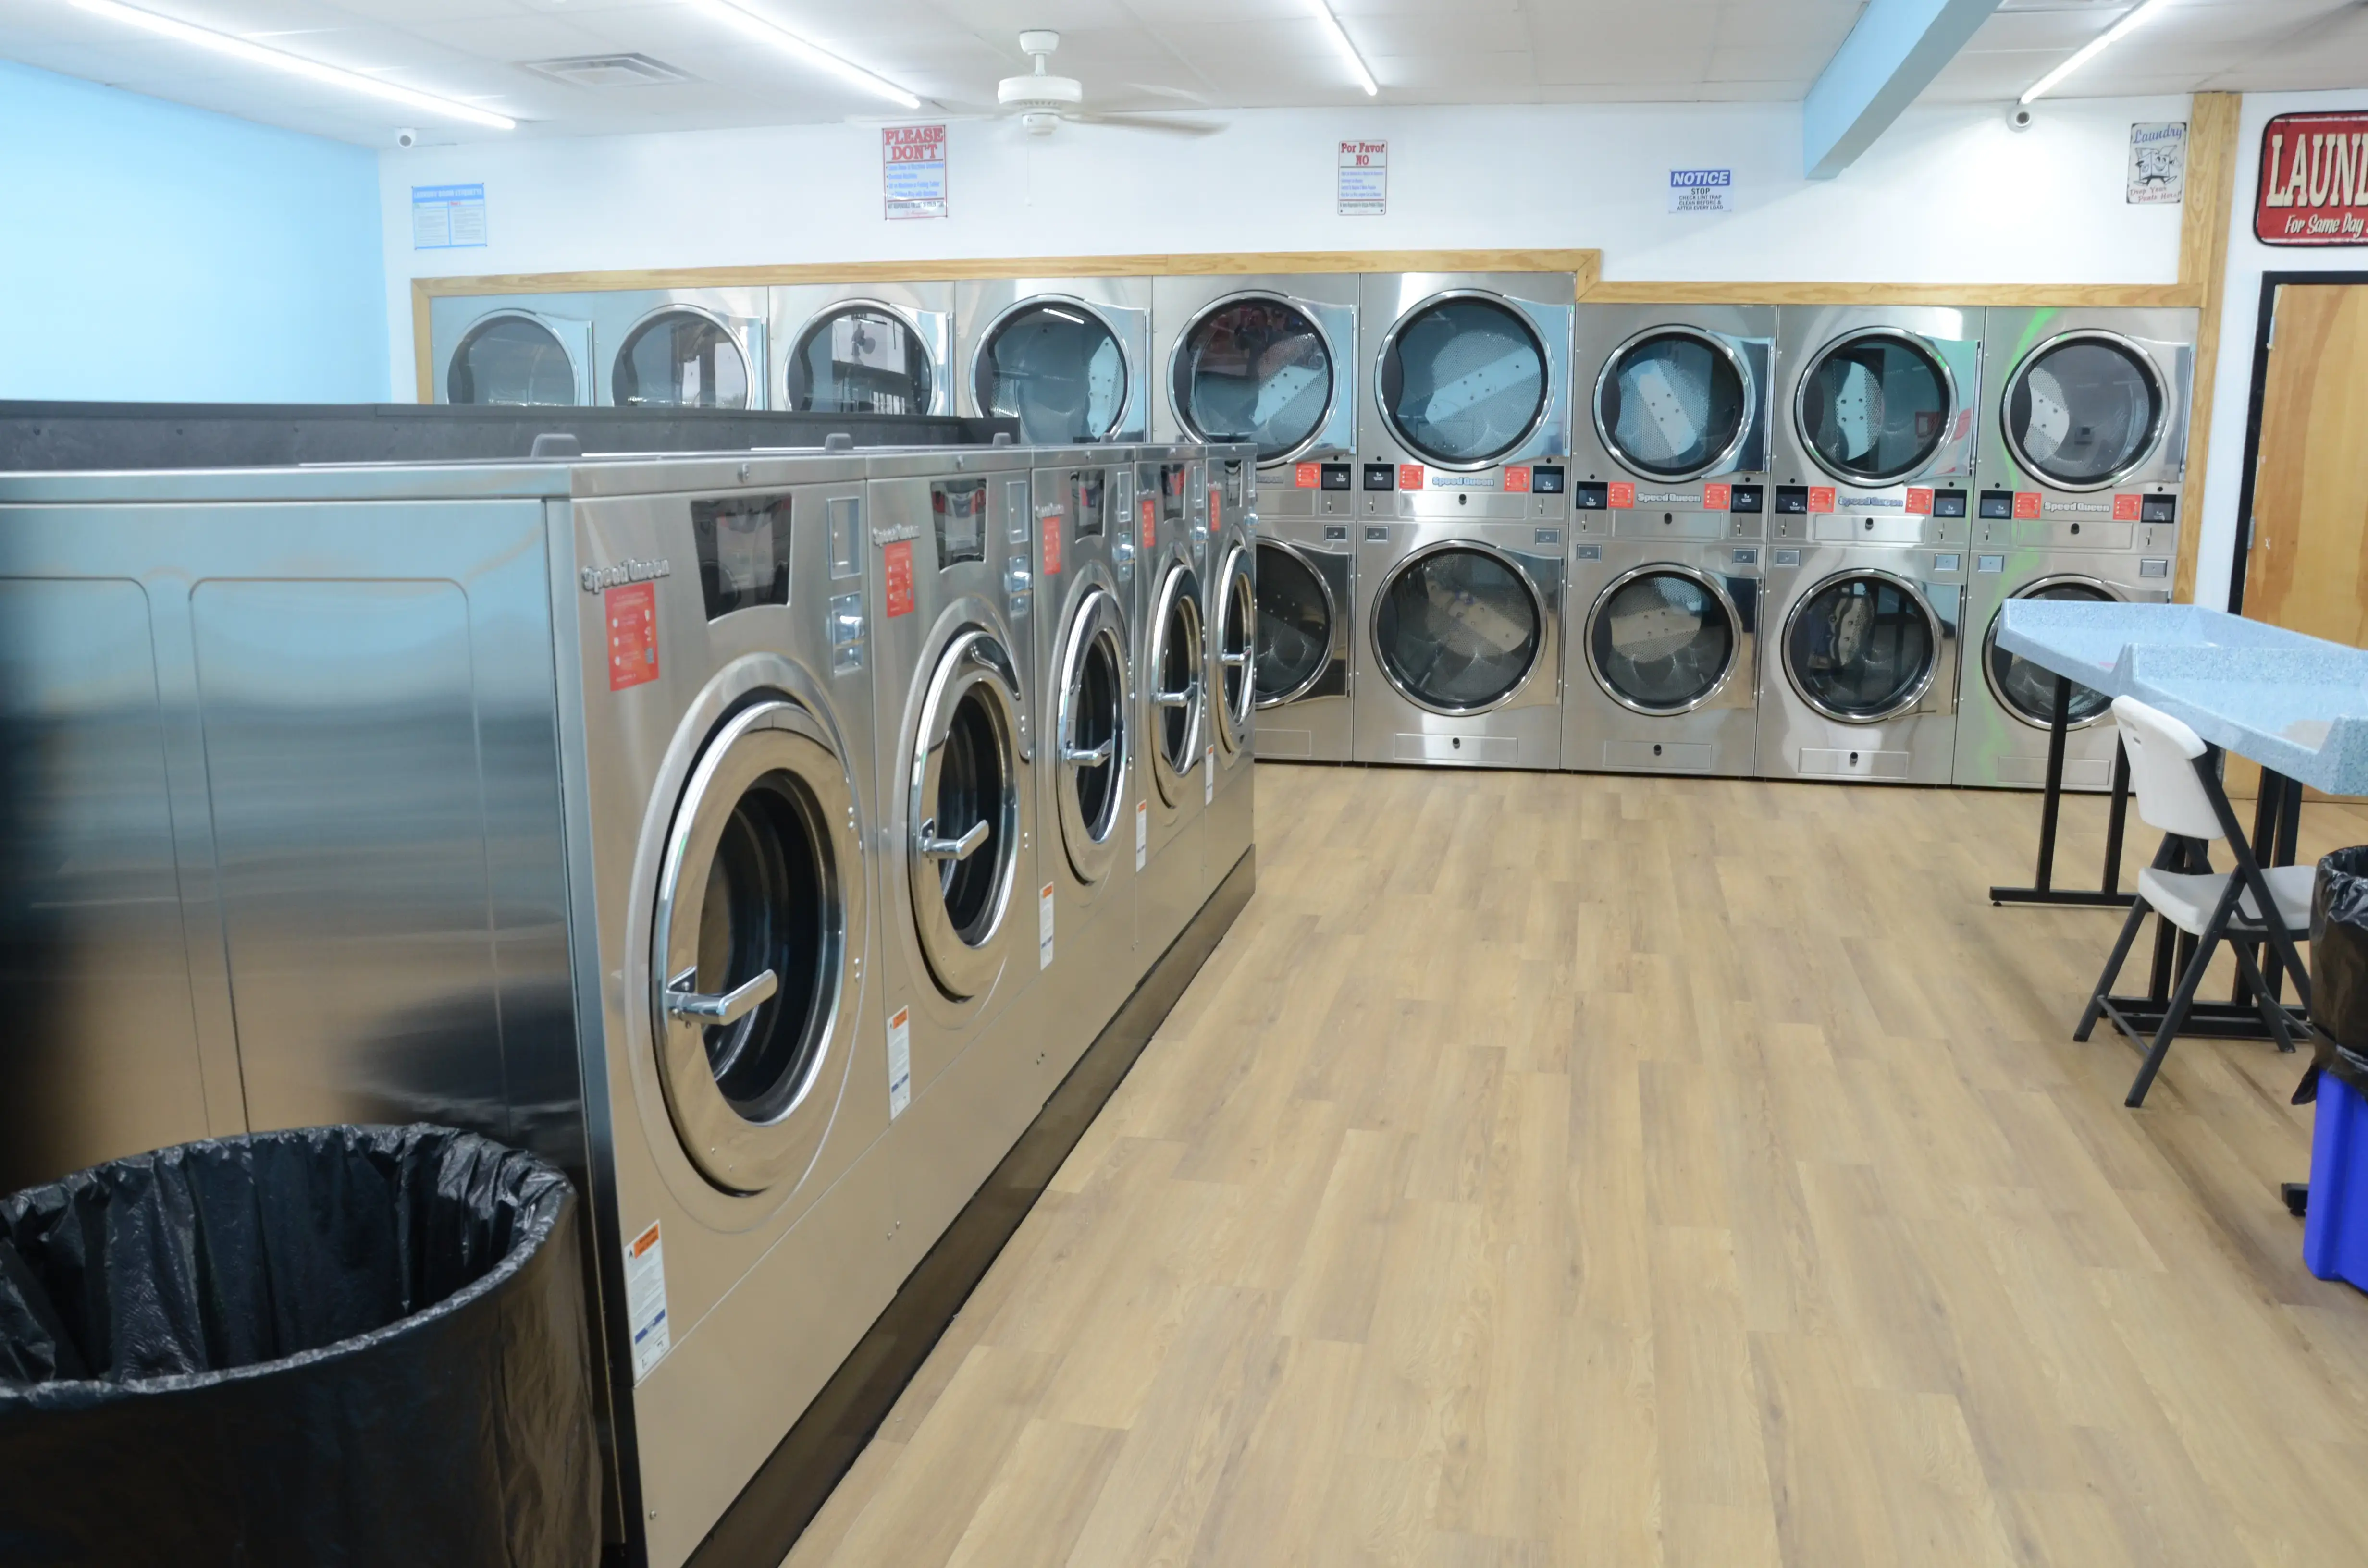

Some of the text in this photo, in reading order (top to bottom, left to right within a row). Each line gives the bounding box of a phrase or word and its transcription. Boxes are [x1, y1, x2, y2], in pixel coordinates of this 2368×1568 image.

[885, 127, 944, 145] PLEASE
[2133, 124, 2183, 144] Laundry
[891, 144, 937, 160] DON'T
[1341, 142, 1384, 153] Por Favor
[1356, 154, 1369, 165] NO
[1672, 172, 1729, 185] NOTICE
[2284, 215, 2305, 234] For
[2307, 213, 2340, 234] Same
[2341, 212, 2364, 238] Day
[1638, 493, 1701, 503] Speed Queen
[2044, 502, 2110, 512] Speed Queen
